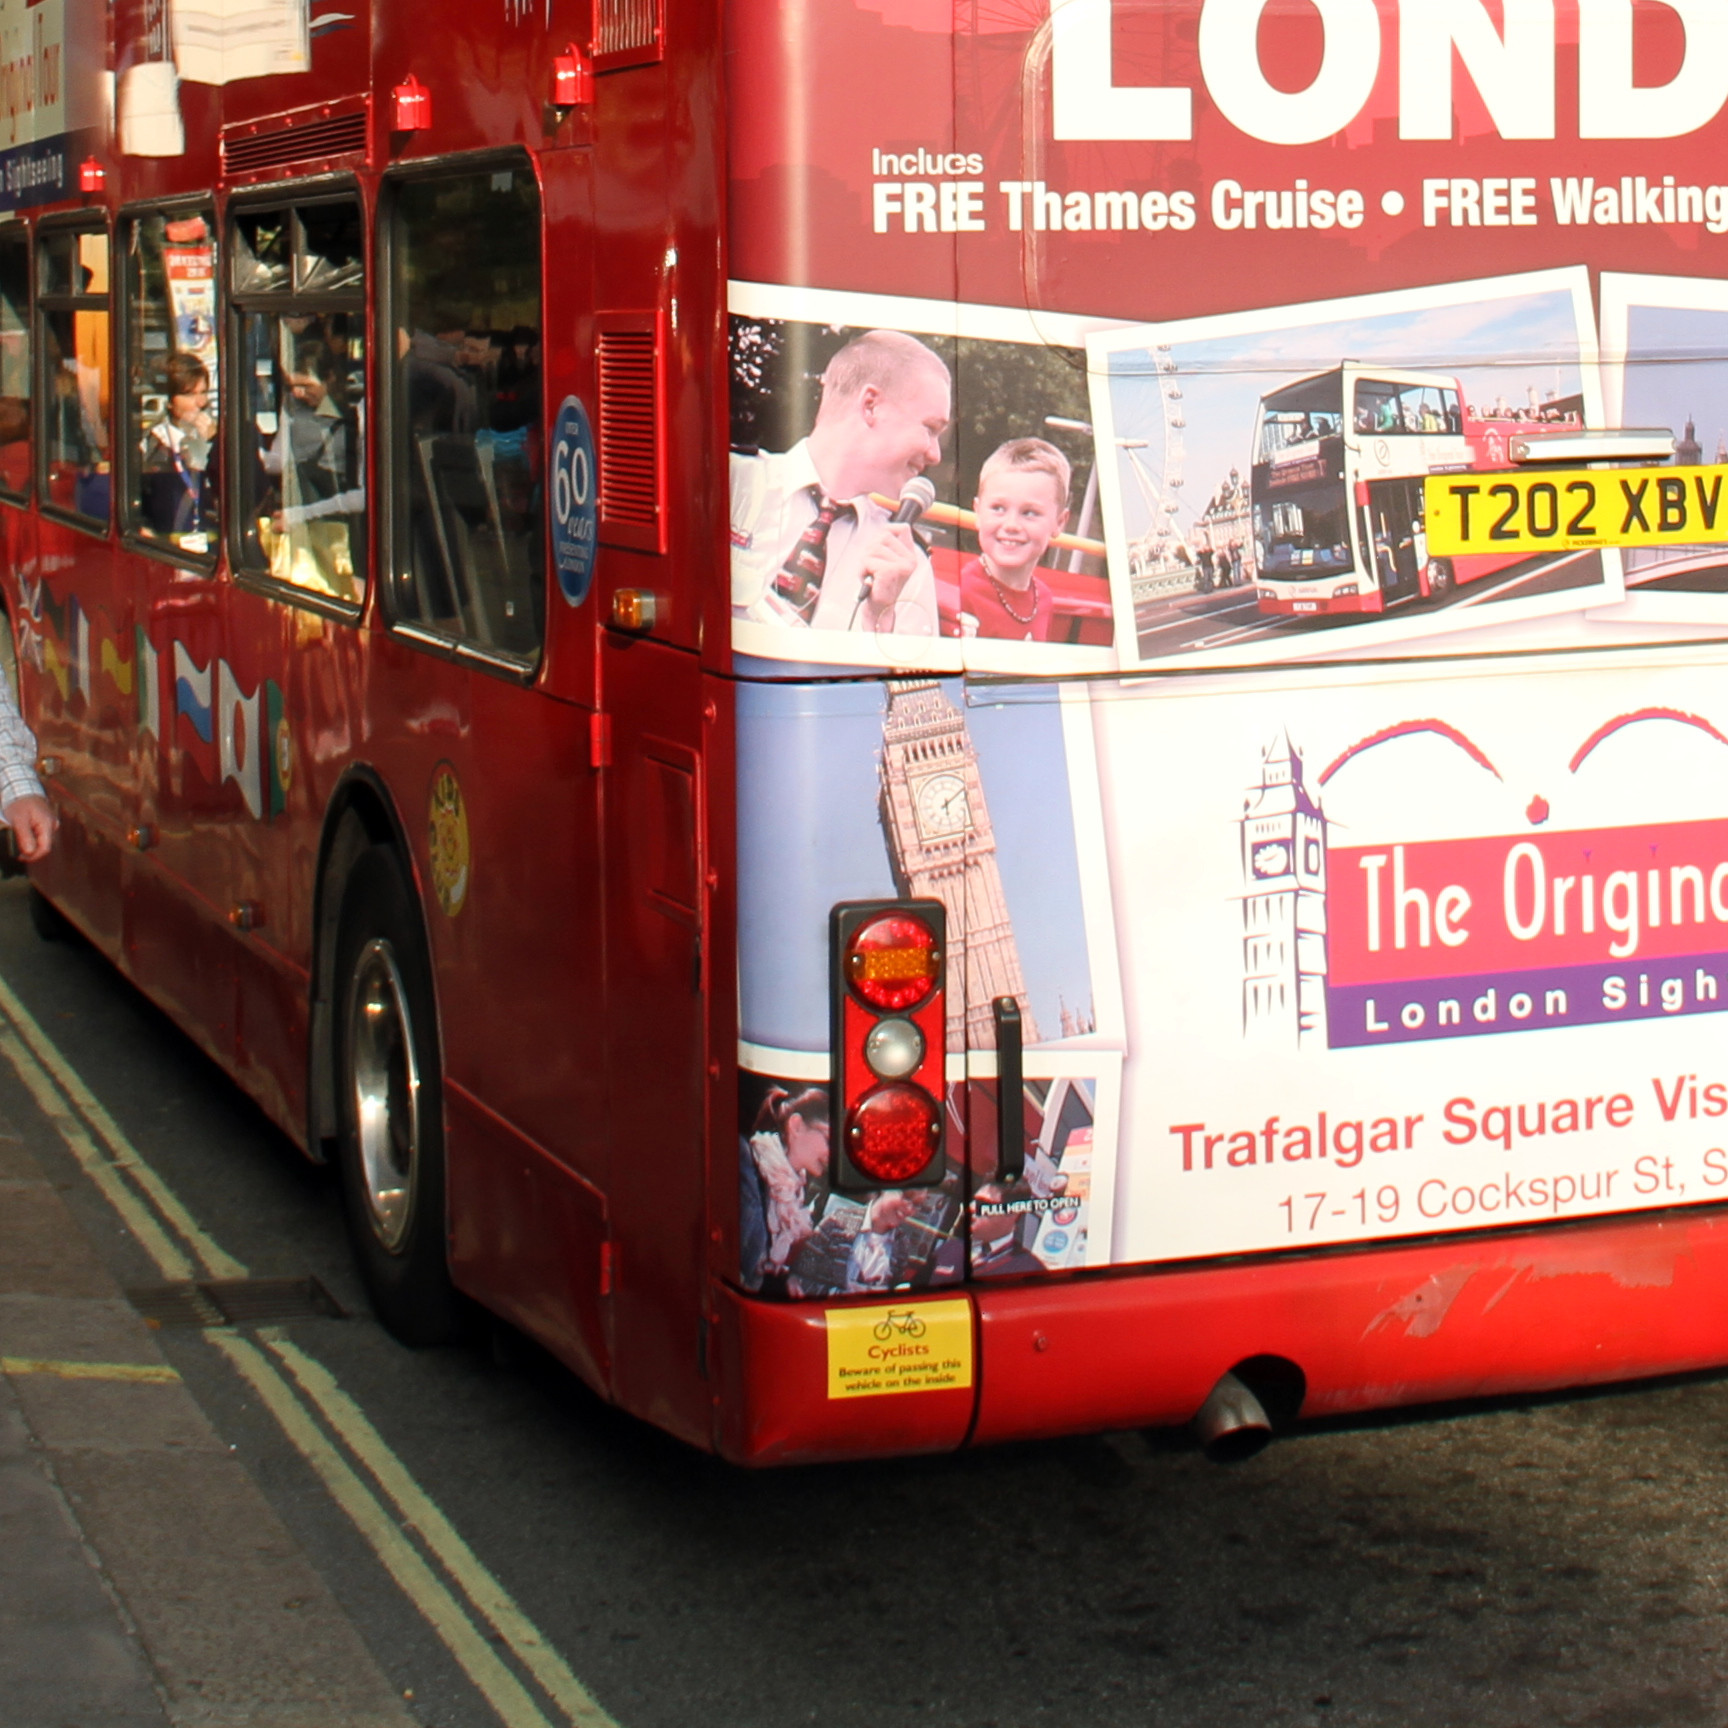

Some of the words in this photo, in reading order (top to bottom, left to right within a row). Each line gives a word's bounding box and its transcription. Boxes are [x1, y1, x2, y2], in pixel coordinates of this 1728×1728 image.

[873, 181, 986, 234] FREE
[999, 181, 1197, 233] Thames
[1211, 179, 1365, 231] Cruise
[1423, 177, 1537, 228] FREE
[555, 440, 588, 524] 60
[1449, 480, 1596, 541] T202
[1619, 475, 1722, 534] XBV
[1359, 845, 1471, 953] The
[1365, 984, 1568, 1033] London
[1170, 1105, 1425, 1174] Trafalgar
[1442, 1081, 1635, 1152] Square
[981, 1204, 1004, 1216] PULL
[1007, 1201, 1031, 1213] HERE
[1034, 1199, 1048, 1210] TO
[1050, 1197, 1079, 1209] OPEN
[1279, 1185, 1401, 1233] 17-19
[1416, 1162, 1619, 1222] Cockspur
[1633, 1152, 1689, 1199] St,
[839, 1365, 880, 1377] Beware
[885, 1363, 896, 1374] of
[899, 1360, 938, 1376] passing
[942, 1358, 961, 1369] this
[867, 1343, 930, 1362] Cyclists
[845, 1378, 882, 1391] vehicle
[885, 1379, 900, 1388] on
[903, 1376, 921, 1386] the
[925, 1373, 956, 1384] inside
